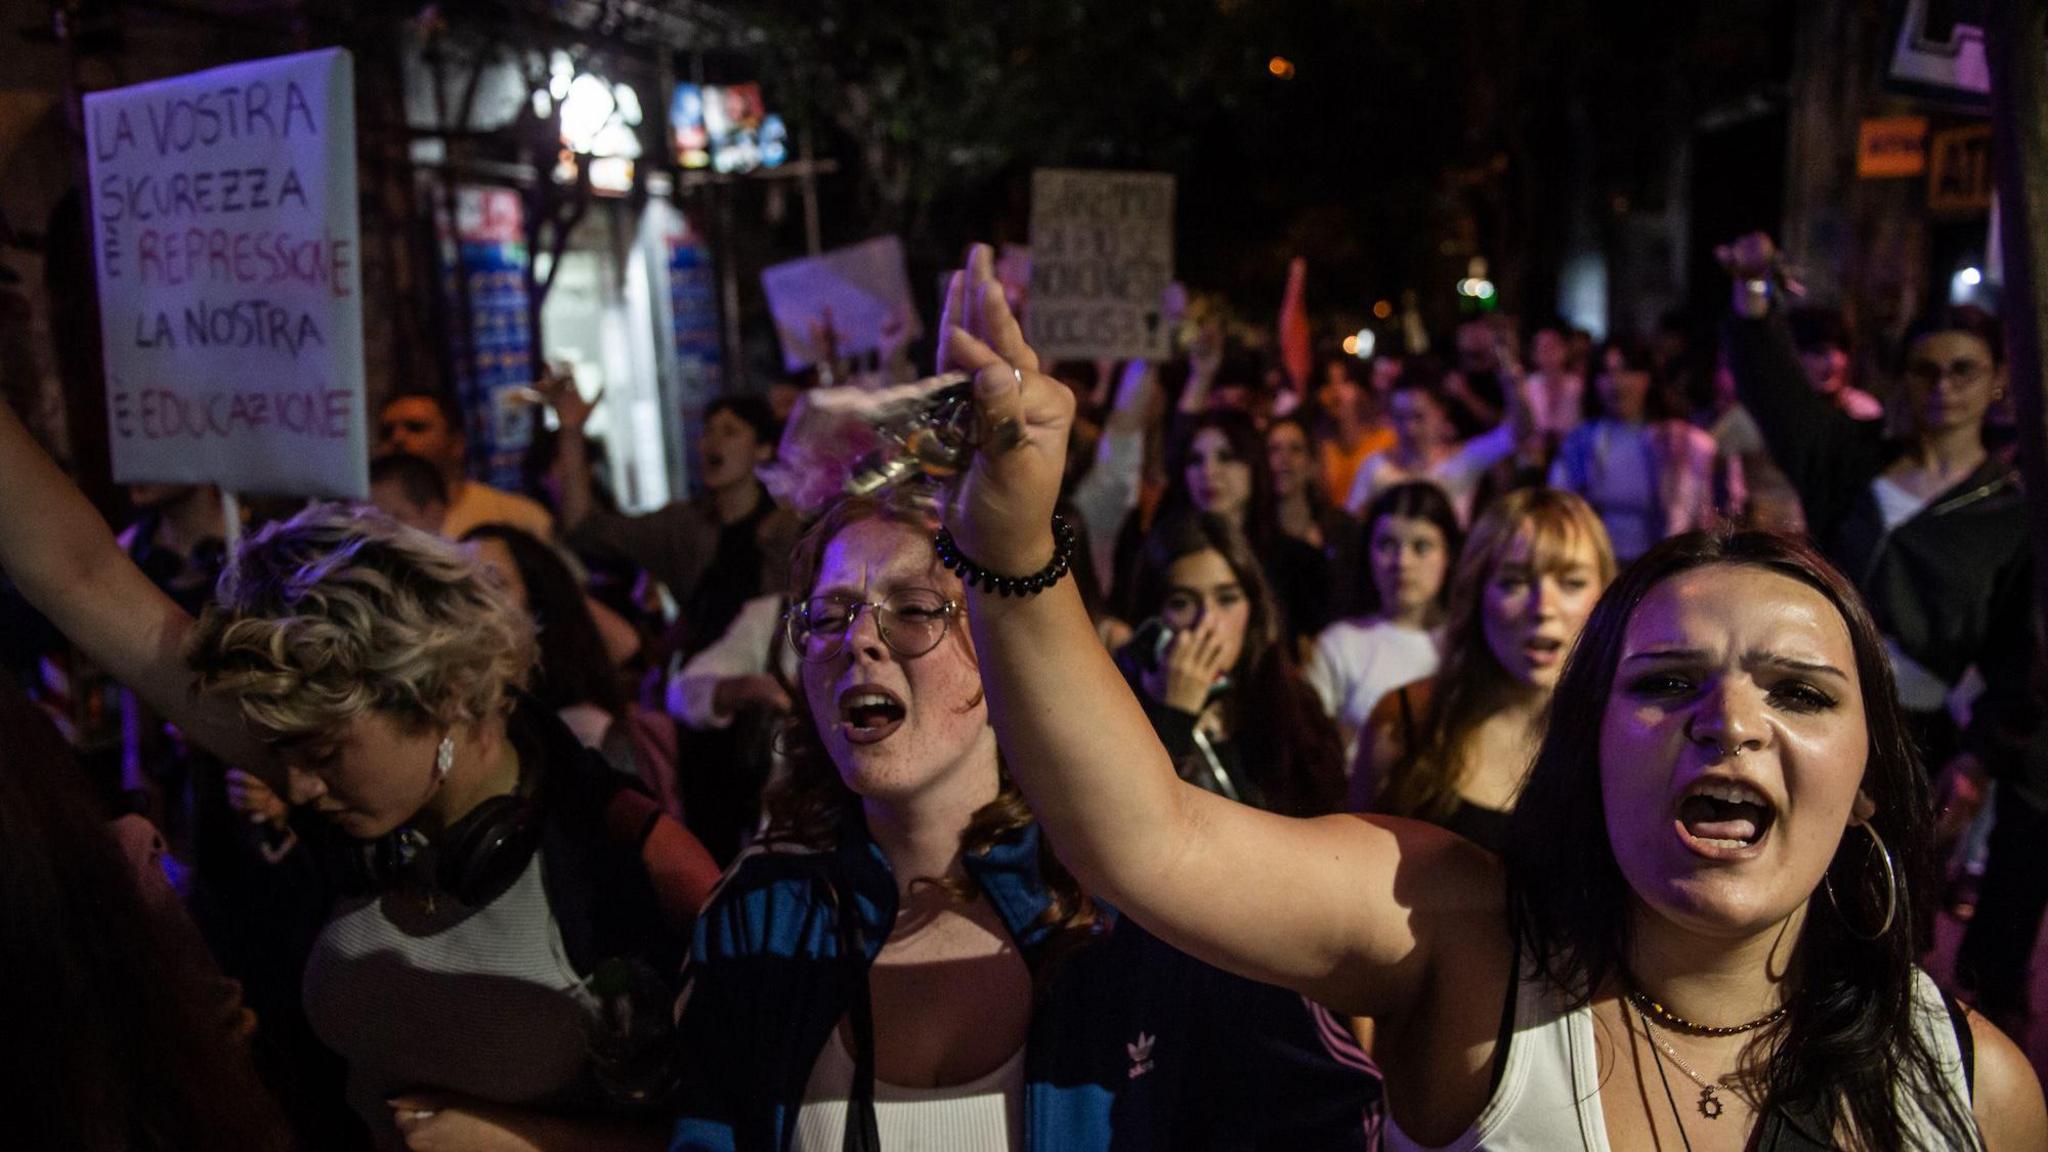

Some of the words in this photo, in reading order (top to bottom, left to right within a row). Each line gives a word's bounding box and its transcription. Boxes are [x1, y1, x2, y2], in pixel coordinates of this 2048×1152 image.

[97, 107, 137, 162] LA
[147, 80, 317, 156] VOSTRA
[101, 166, 309, 222] SICUREZZA
[138, 227, 351, 297] REPRESSIONE
[136, 310, 175, 349] LA
[184, 299, 325, 358] NOSTRA
[139, 385, 352, 439] EDUCAZIONE
